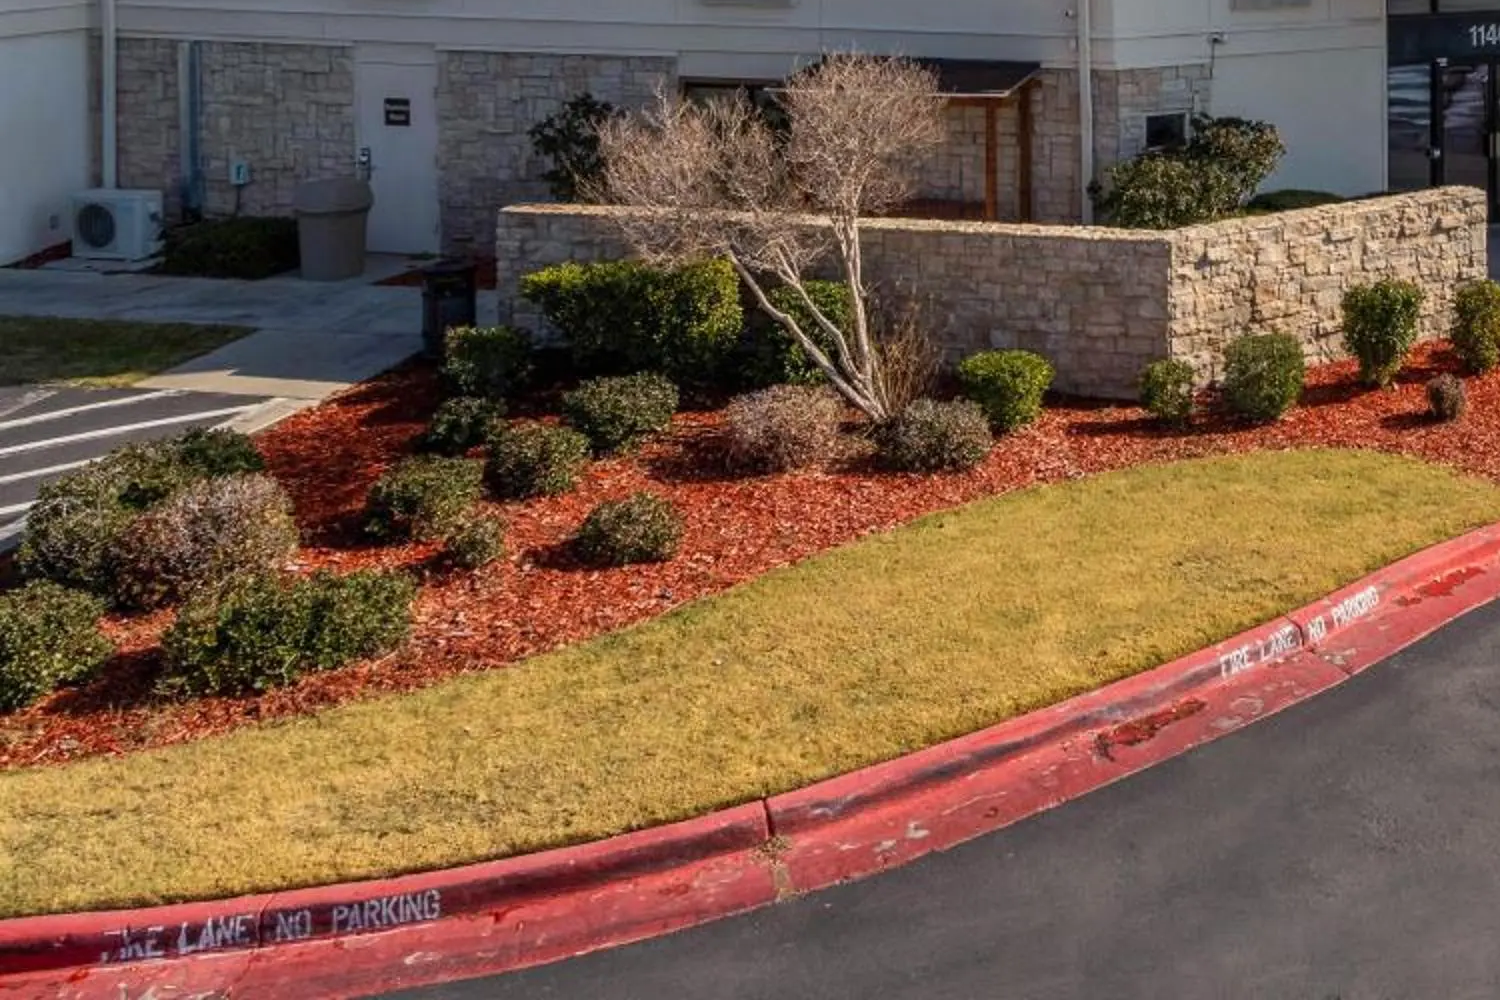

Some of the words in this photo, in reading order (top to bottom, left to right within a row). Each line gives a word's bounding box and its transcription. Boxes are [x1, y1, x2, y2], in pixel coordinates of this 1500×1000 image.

[177, 914, 254, 954] LANE
[275, 909, 312, 941] NO
[332, 889, 441, 934] PARKING
